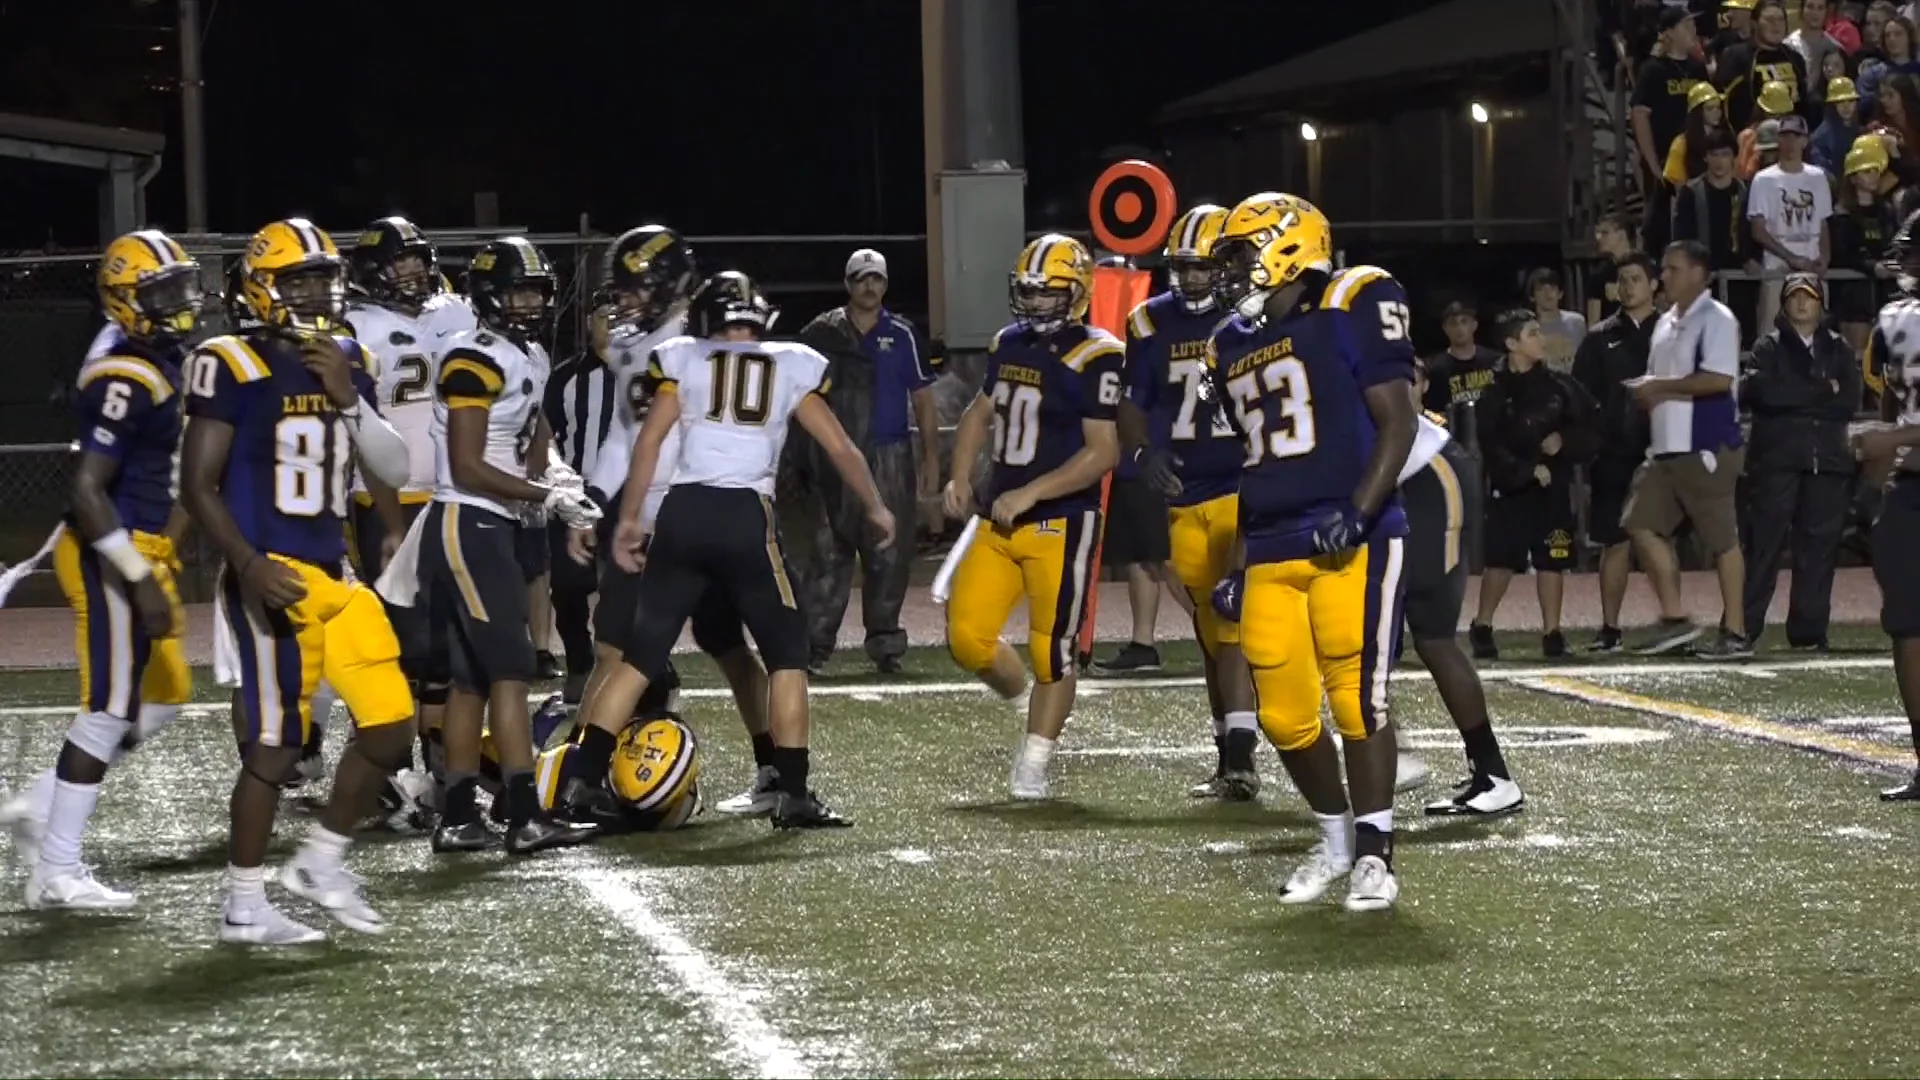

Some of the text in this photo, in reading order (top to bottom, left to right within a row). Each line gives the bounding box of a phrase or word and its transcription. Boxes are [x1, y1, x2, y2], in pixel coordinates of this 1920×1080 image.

[391, 352, 437, 408] 2
[705, 351, 778, 426] 10
[1228, 337, 1293, 377] LUTCHER
[102, 381, 132, 421] 6
[989, 381, 1044, 467] 60
[1226, 355, 1317, 469] 53
